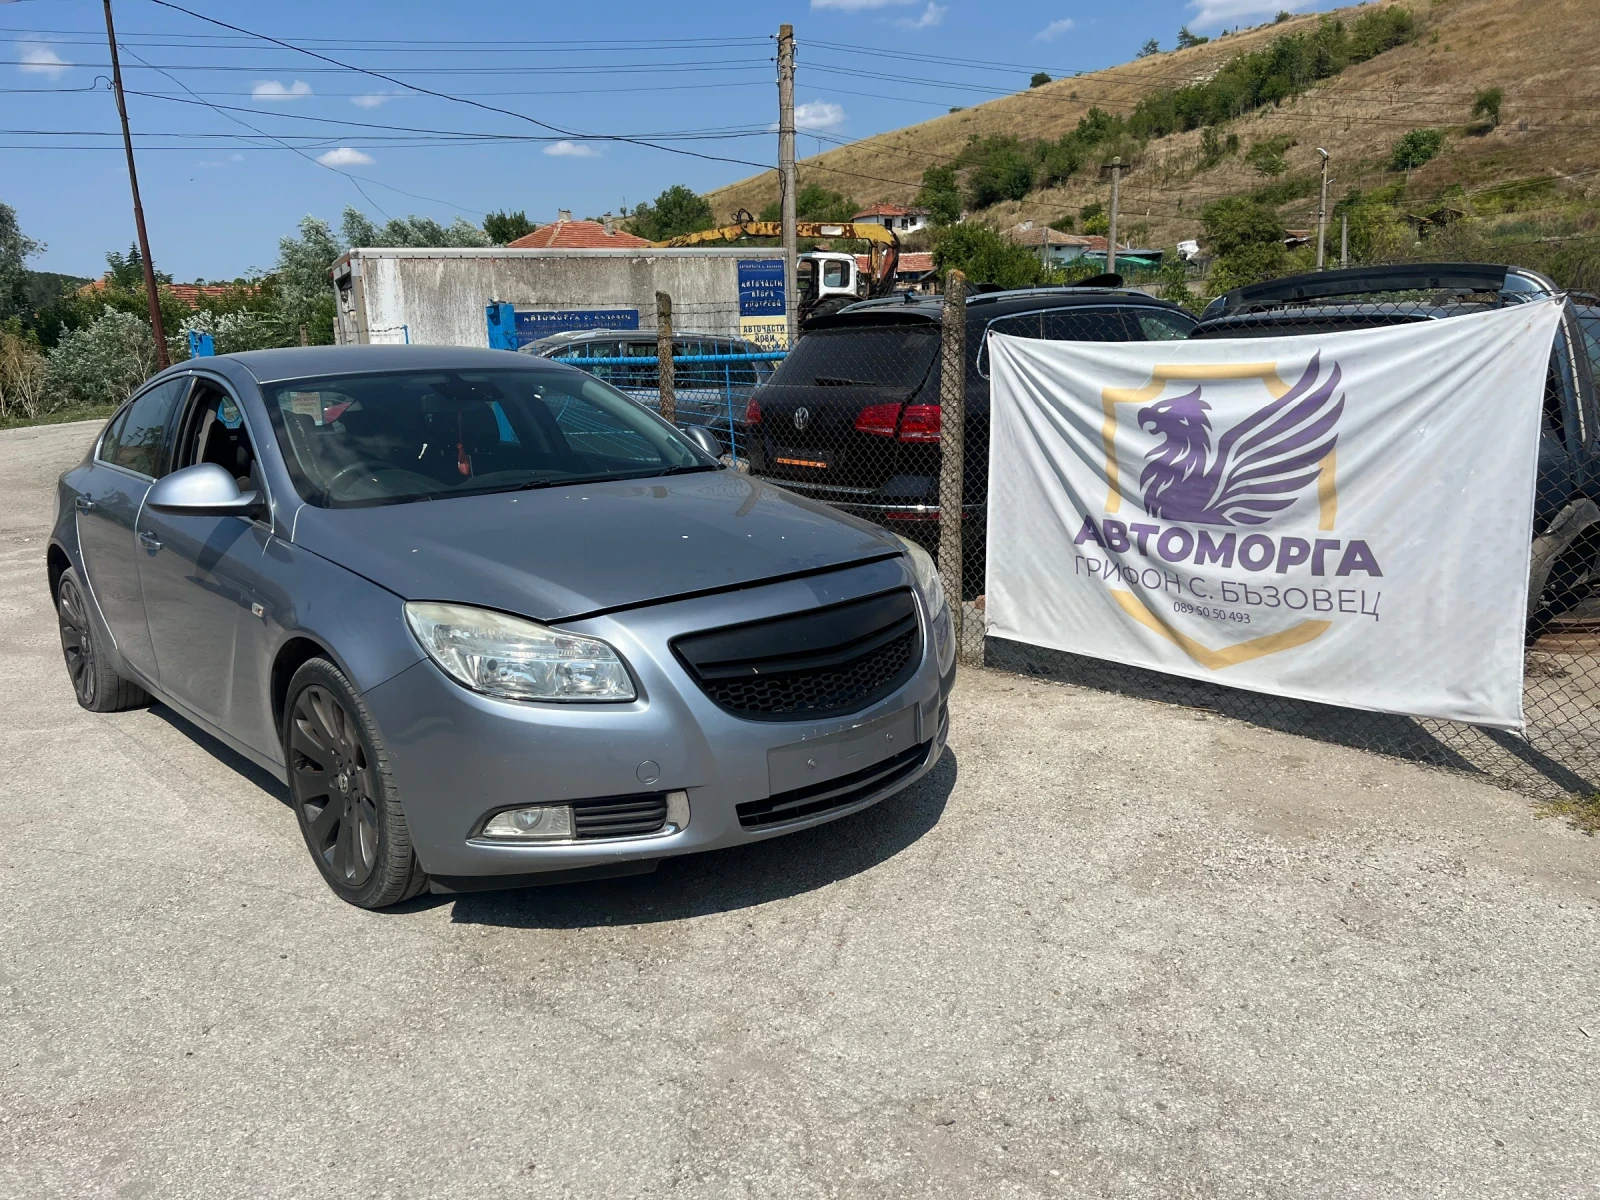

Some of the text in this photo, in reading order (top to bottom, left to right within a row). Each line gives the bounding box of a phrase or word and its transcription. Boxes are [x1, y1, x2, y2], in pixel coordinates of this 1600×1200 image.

[743, 324, 785, 333] АВТОЧАСТИ
[1074, 514, 1383, 577] АВТОМОРГА
[1075, 556, 1181, 594] ГРИФОН
[1221, 581, 1381, 621] БЪЗОВЕЦ
[1173, 601, 1252, 624] 089 50 50 493
